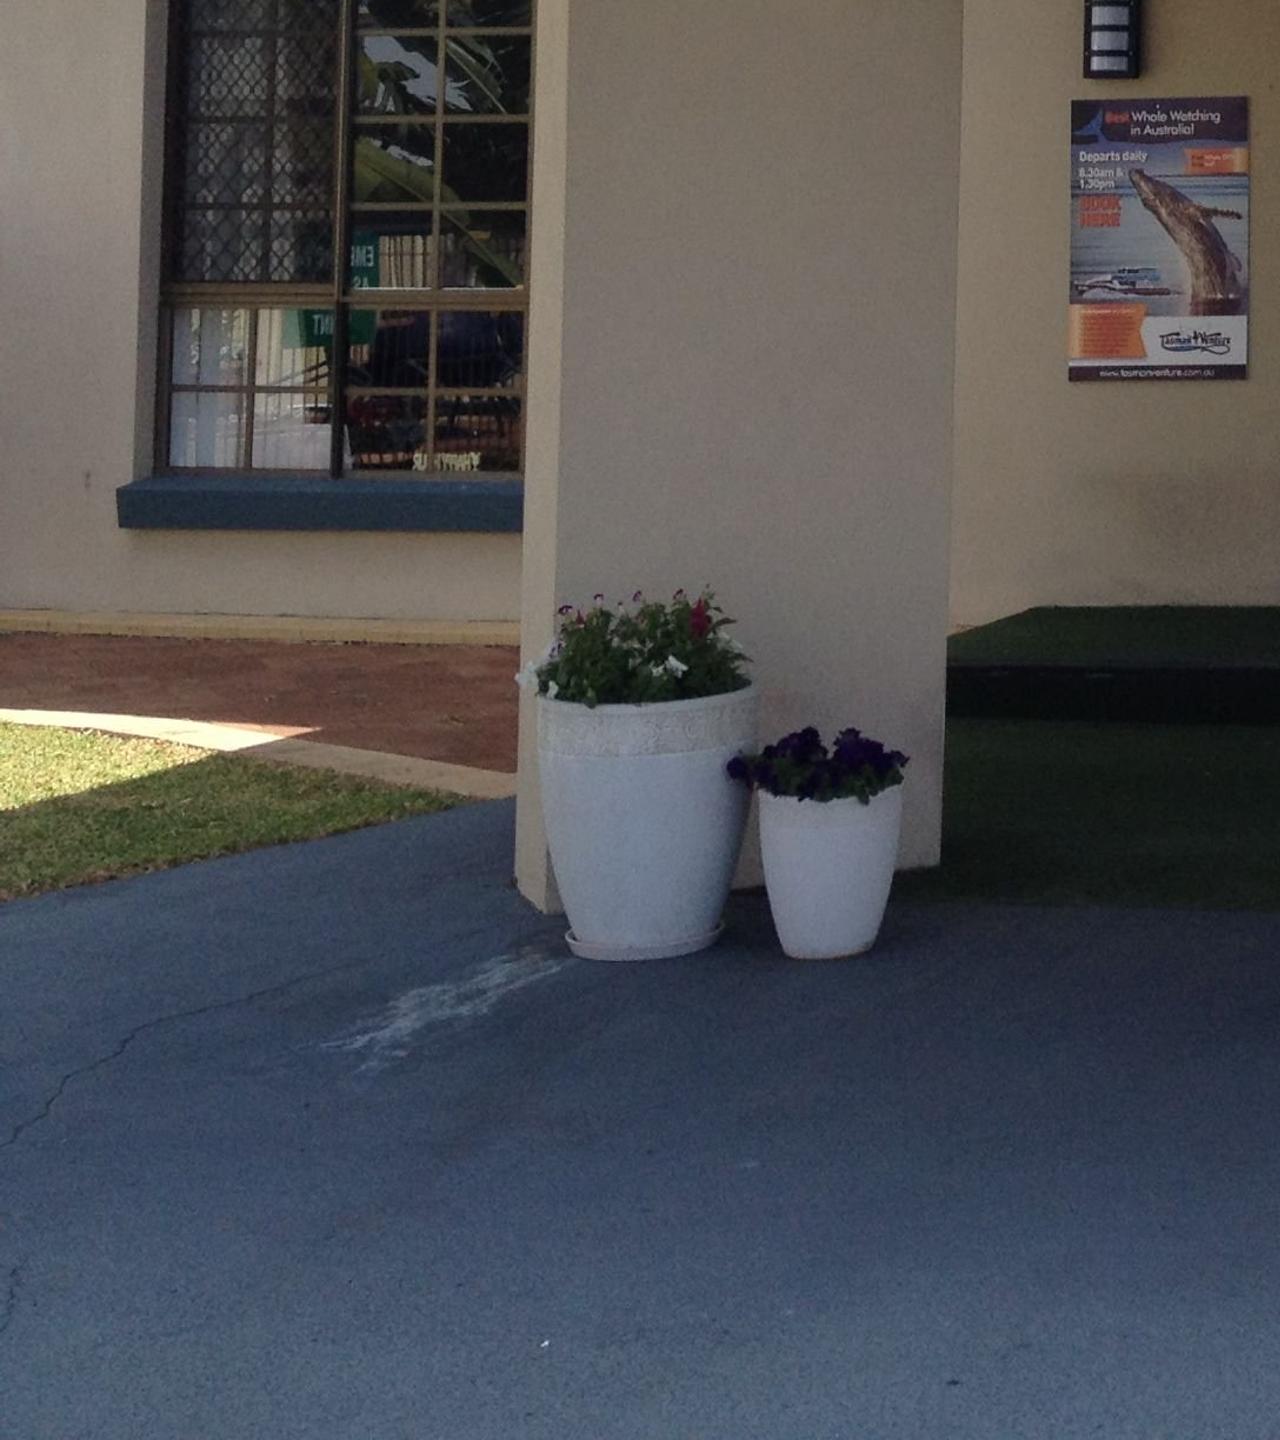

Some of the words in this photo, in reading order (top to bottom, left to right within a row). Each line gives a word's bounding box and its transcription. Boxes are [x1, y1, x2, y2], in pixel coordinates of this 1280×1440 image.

[1131, 110, 1168, 124] Whale
[1170, 109, 1221, 125] Watching
[1079, 151, 1121, 164] Departs
[1122, 150, 1148, 164] daily
